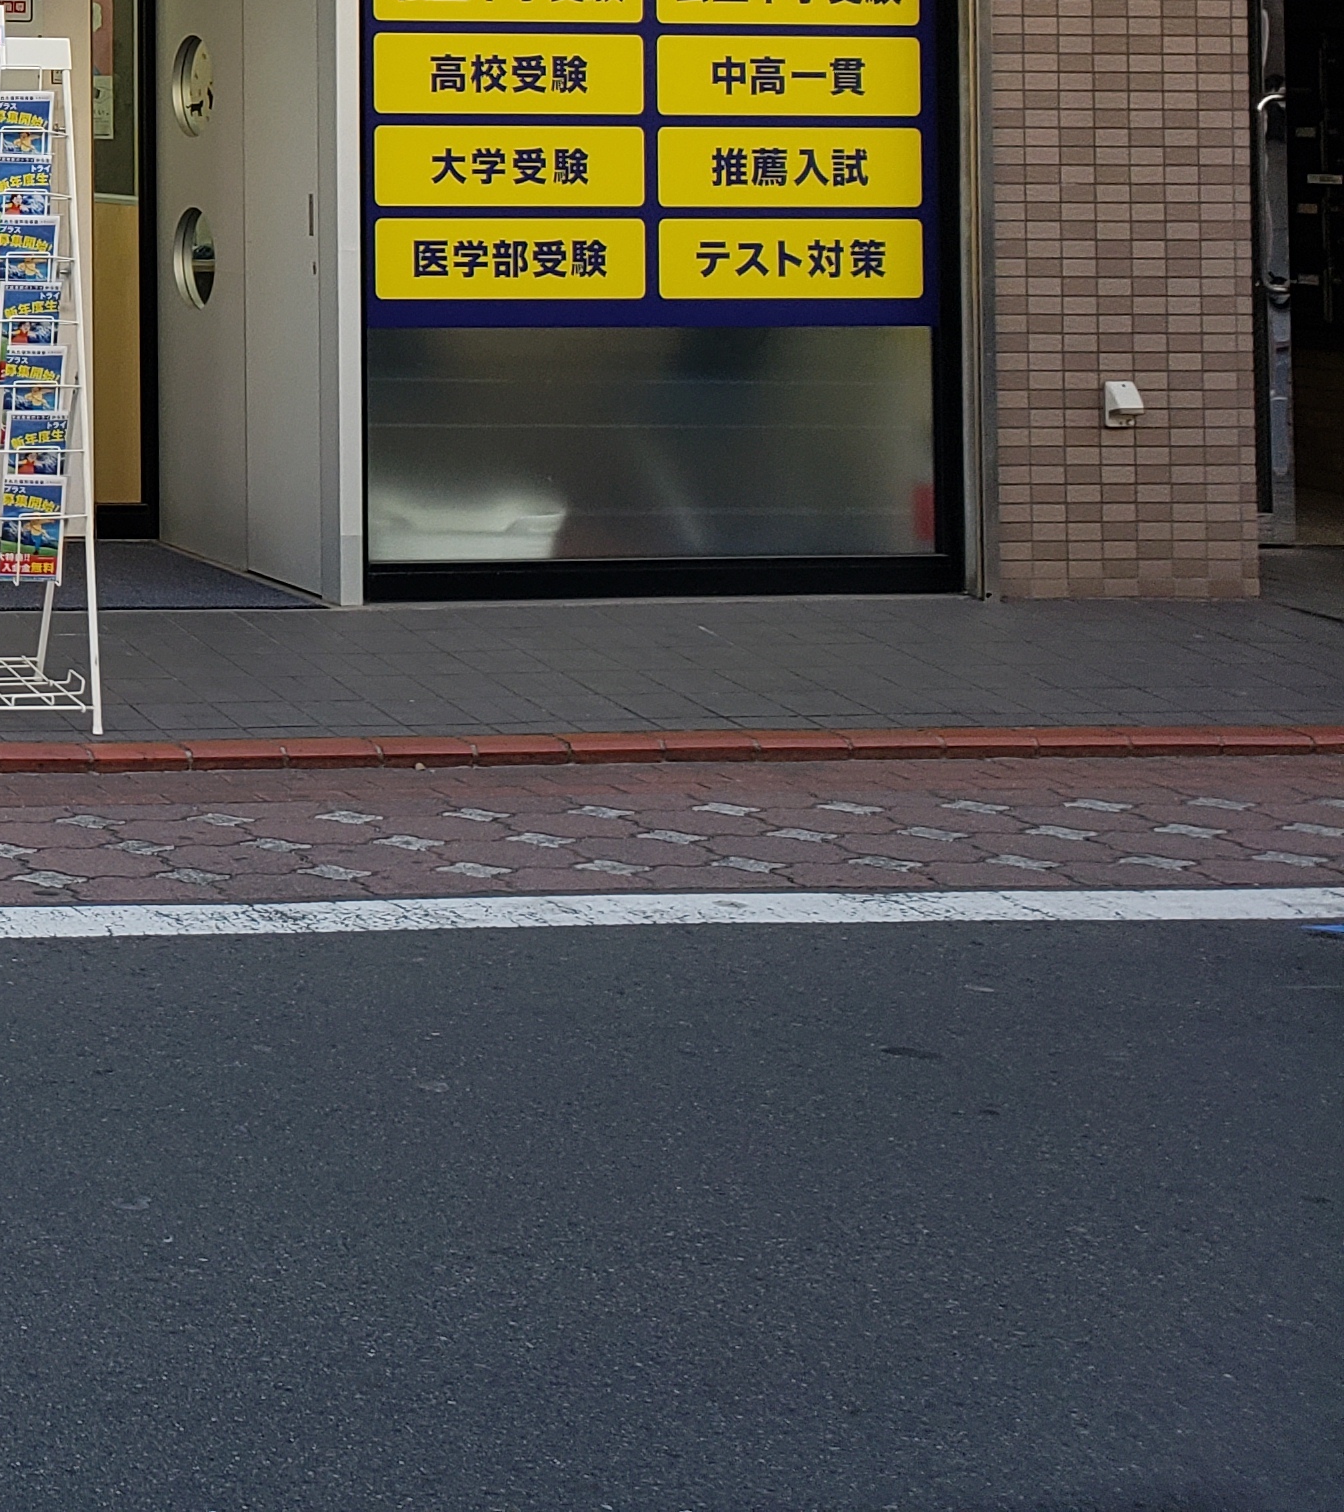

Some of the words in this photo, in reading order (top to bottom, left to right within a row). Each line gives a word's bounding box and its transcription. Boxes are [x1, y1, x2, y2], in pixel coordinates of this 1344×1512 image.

[429, 54, 588, 94] 高校受験
[711, 56, 866, 97] 中高一貫
[431, 147, 589, 185] 大学受験
[711, 147, 869, 187] 推薦入試
[412, 239, 608, 279] 医学部受験
[696, 239, 886, 279] テスト対策
